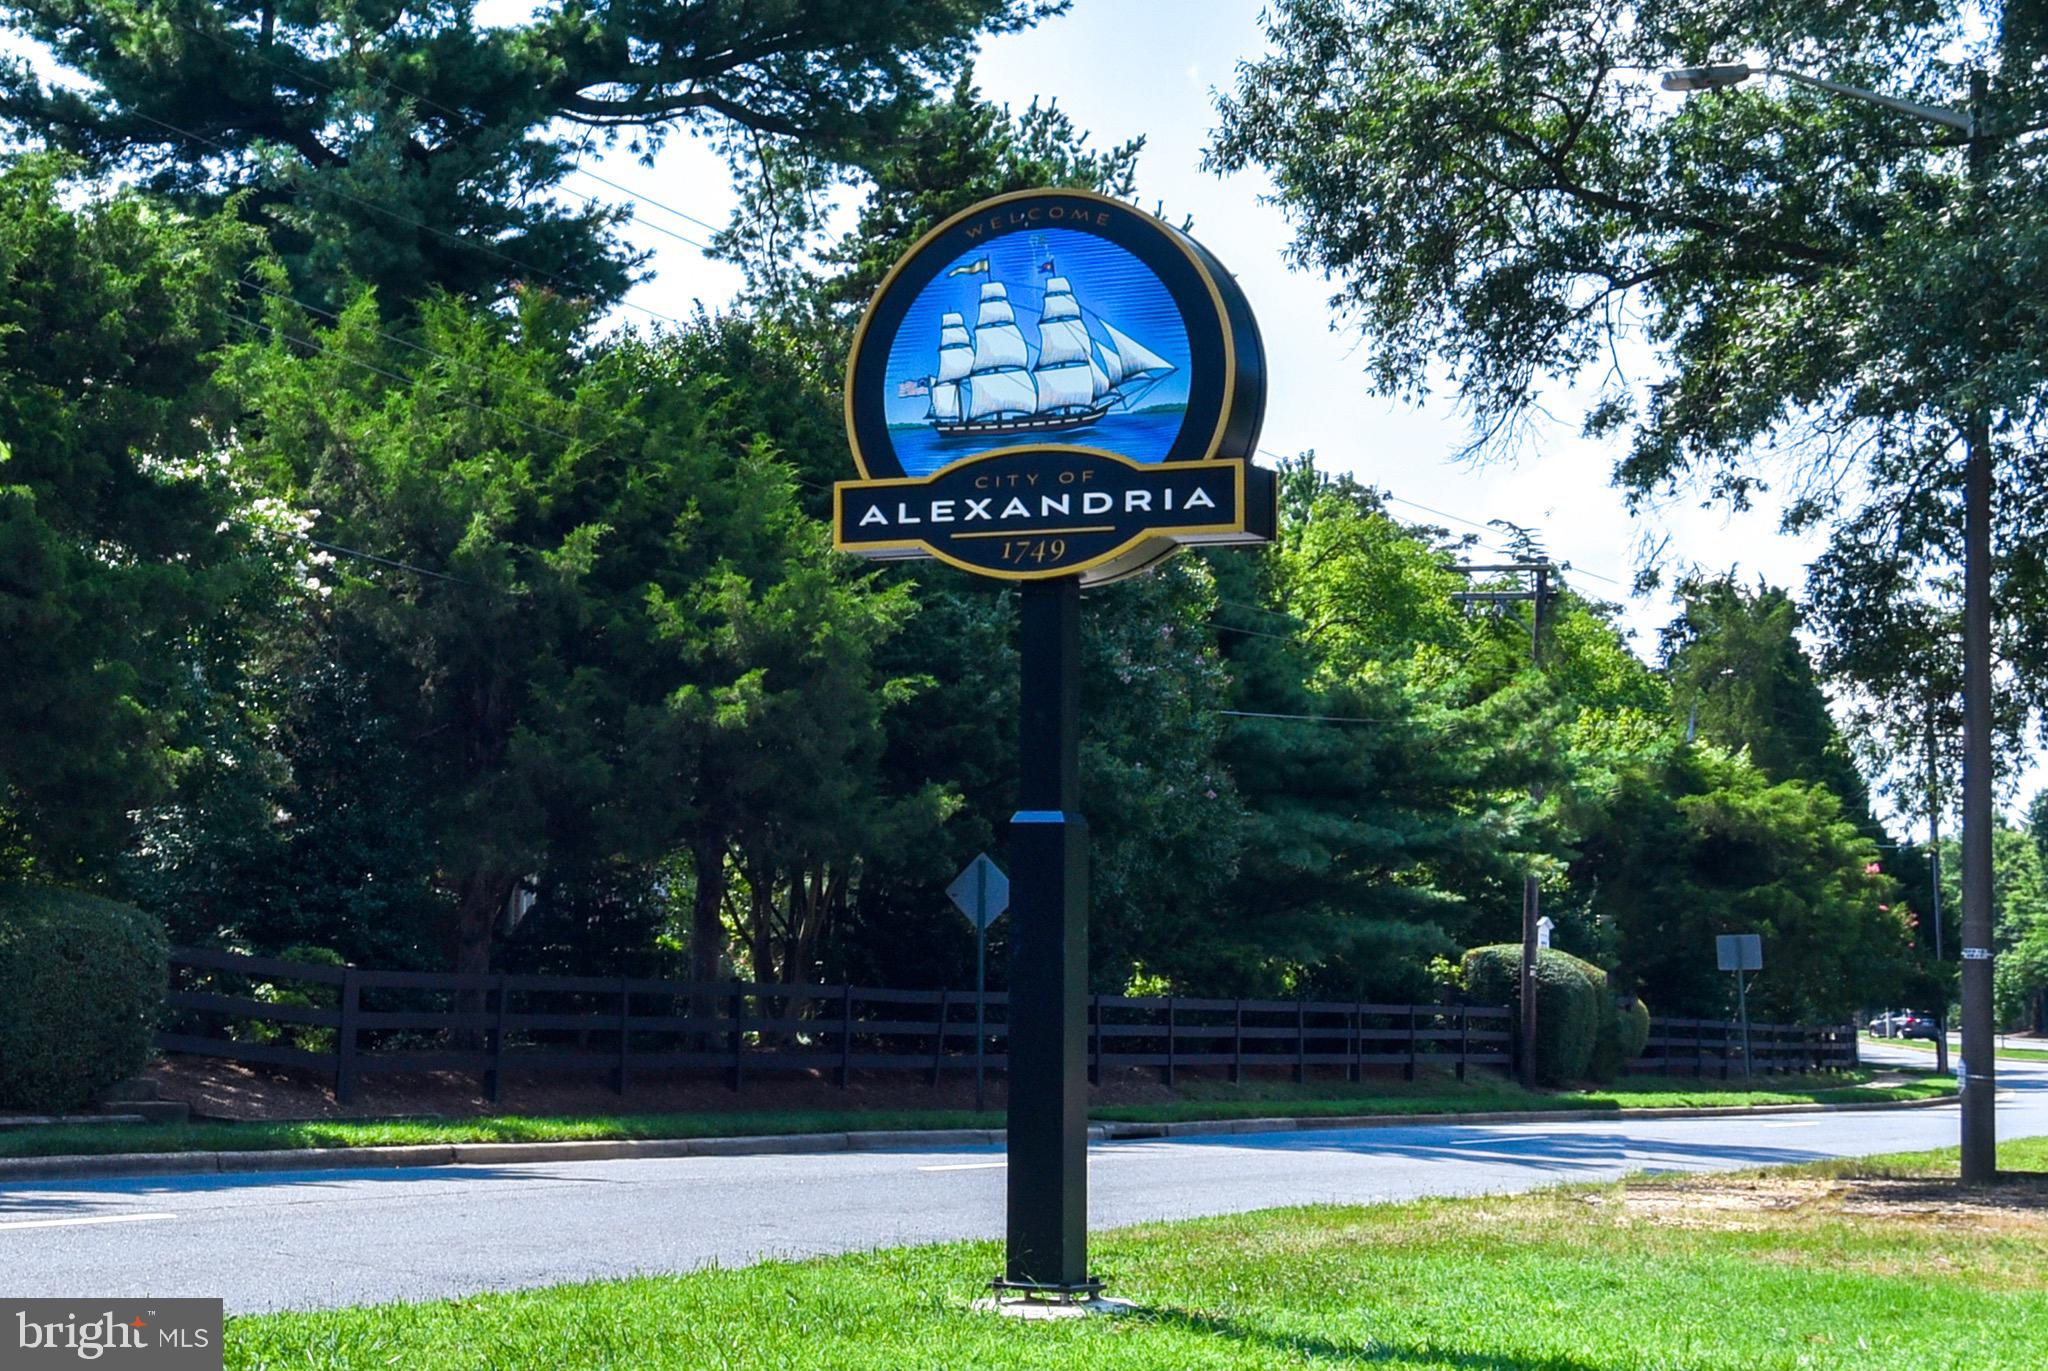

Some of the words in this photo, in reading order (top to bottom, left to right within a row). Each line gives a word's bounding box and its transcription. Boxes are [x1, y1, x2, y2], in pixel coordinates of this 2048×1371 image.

[965, 207, 1111, 239] WELCOME
[975, 474, 1039, 489] CITY
[1058, 469, 1095, 485] OF
[858, 487, 1216, 527] ALEXANDRIA
[1001, 538, 1067, 565] 1749
